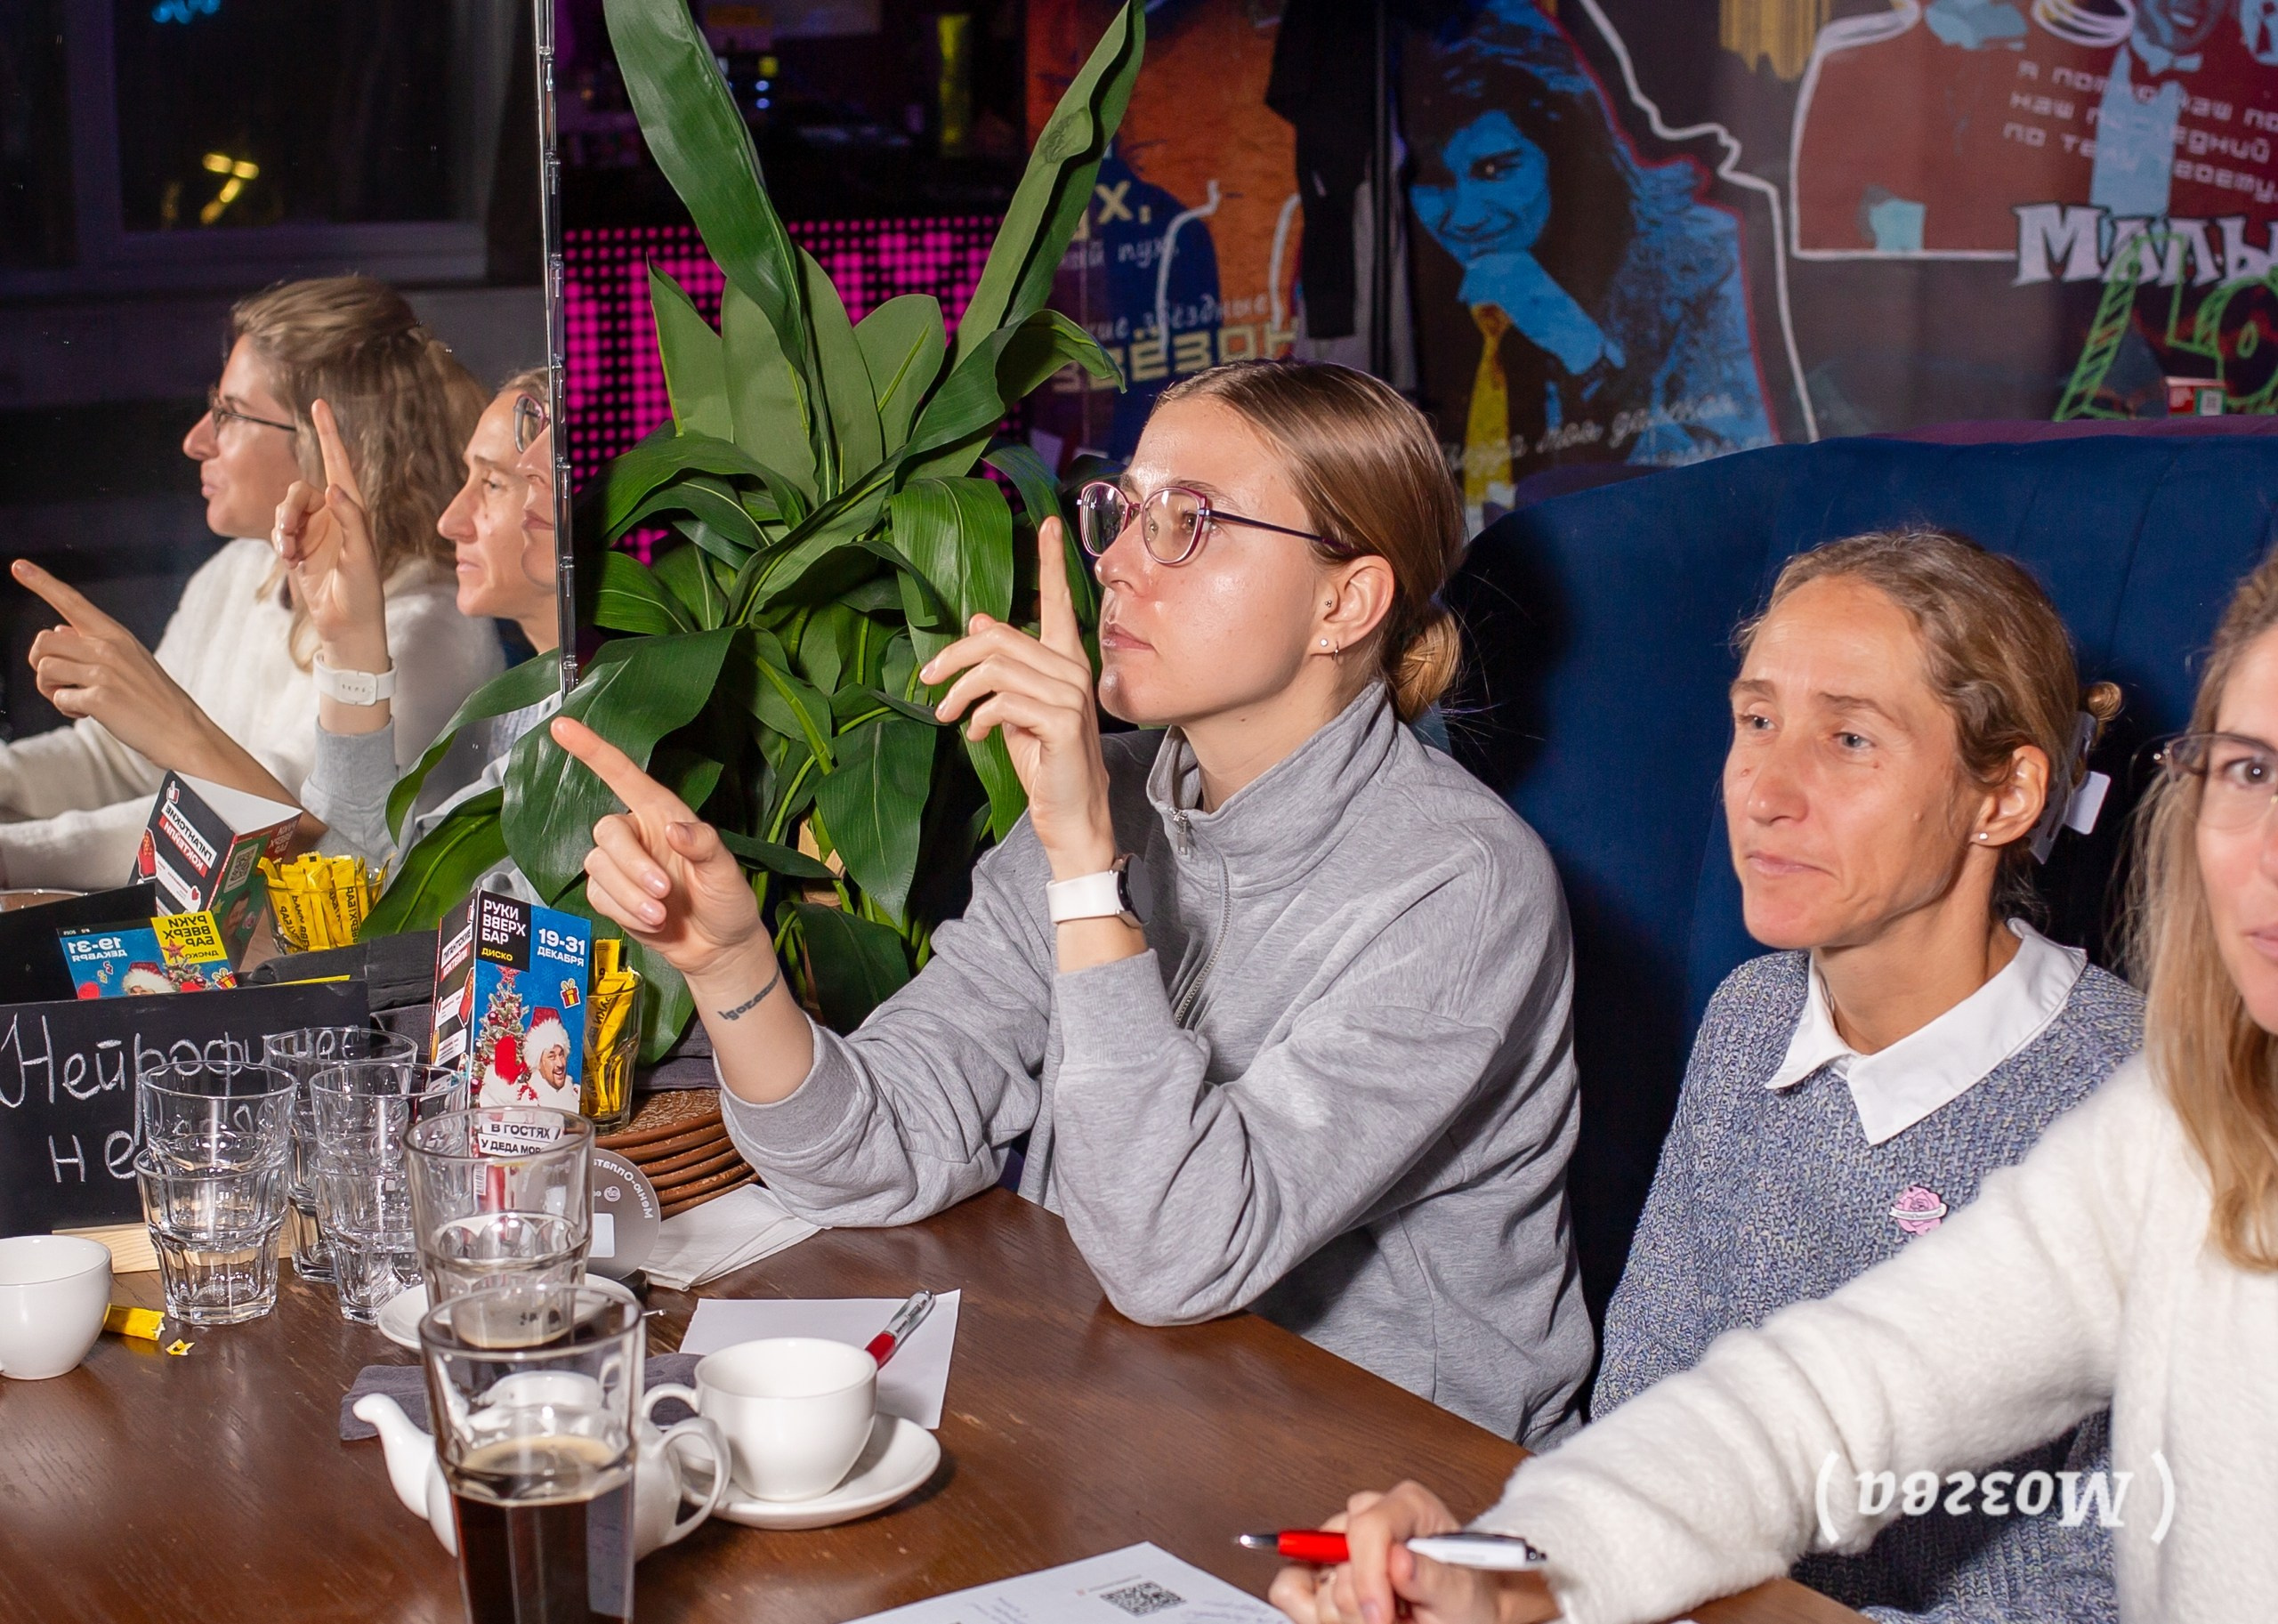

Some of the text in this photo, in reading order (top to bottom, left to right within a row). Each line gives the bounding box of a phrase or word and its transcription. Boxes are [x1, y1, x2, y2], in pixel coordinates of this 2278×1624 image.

[483, 899, 520, 920] РУКИ
[481, 913, 527, 937] ВВЕРХ
[481, 928, 510, 945] БАР
[538, 927, 586, 956] 19-31
[481, 947, 513, 962] ДИСКО
[537, 945, 585, 967] ДЕКАБРЯ
[490, 1123, 551, 1140] В ГОСТЯХ
[481, 1139, 544, 1155] У ДЕДА МОР
